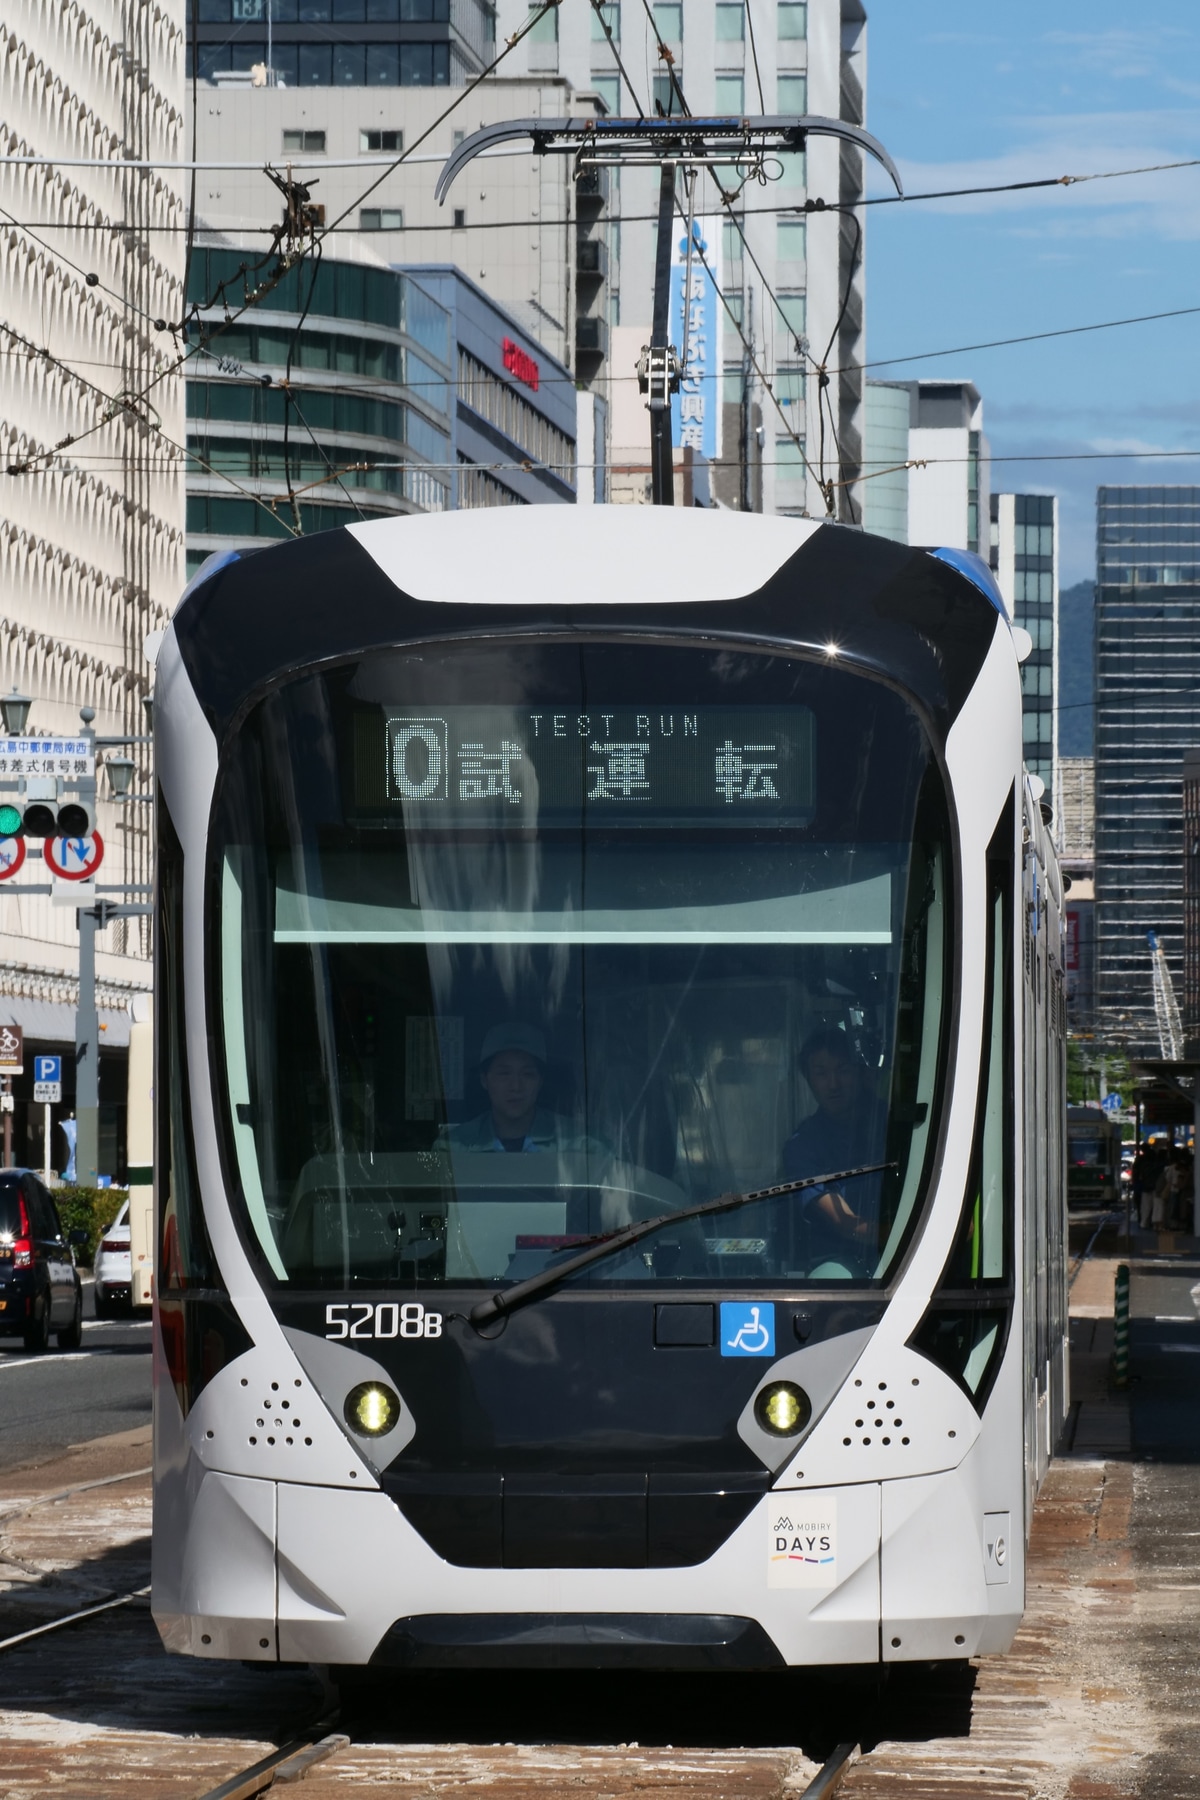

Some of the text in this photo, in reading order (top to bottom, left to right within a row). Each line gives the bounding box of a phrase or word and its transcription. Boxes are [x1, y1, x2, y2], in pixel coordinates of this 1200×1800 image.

[530, 715, 698, 736] TEST RUN
[392, 724, 442, 798] 0
[41, 1058, 56, 1080] P
[325, 1303, 443, 1339] 5208B
[796, 1522, 832, 1532] MOBIRY
[775, 1536, 831, 1552] DAYS
